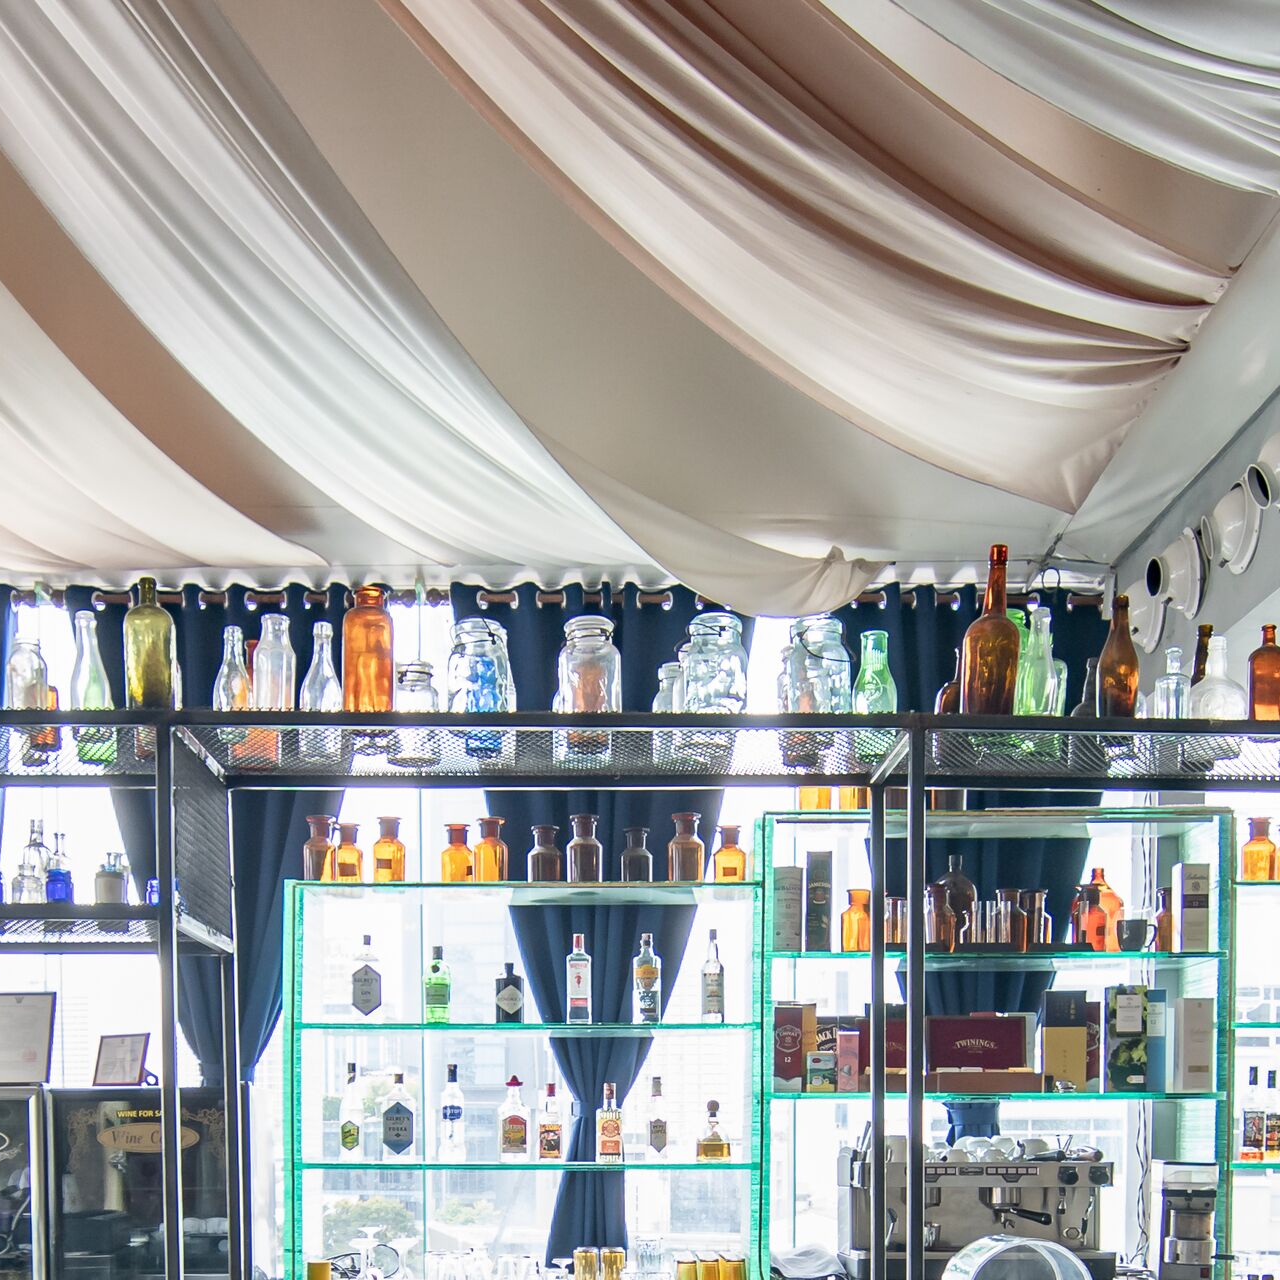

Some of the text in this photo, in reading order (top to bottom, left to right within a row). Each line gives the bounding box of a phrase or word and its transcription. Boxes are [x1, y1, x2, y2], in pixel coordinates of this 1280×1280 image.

[808, 881, 832, 889] JAMESON
[816, 1029, 832, 1045] JACK
[955, 1038, 995, 1049] TWININGS
[116, 1110, 137, 1118] WINE
[138, 1110, 153, 1118] FOR
